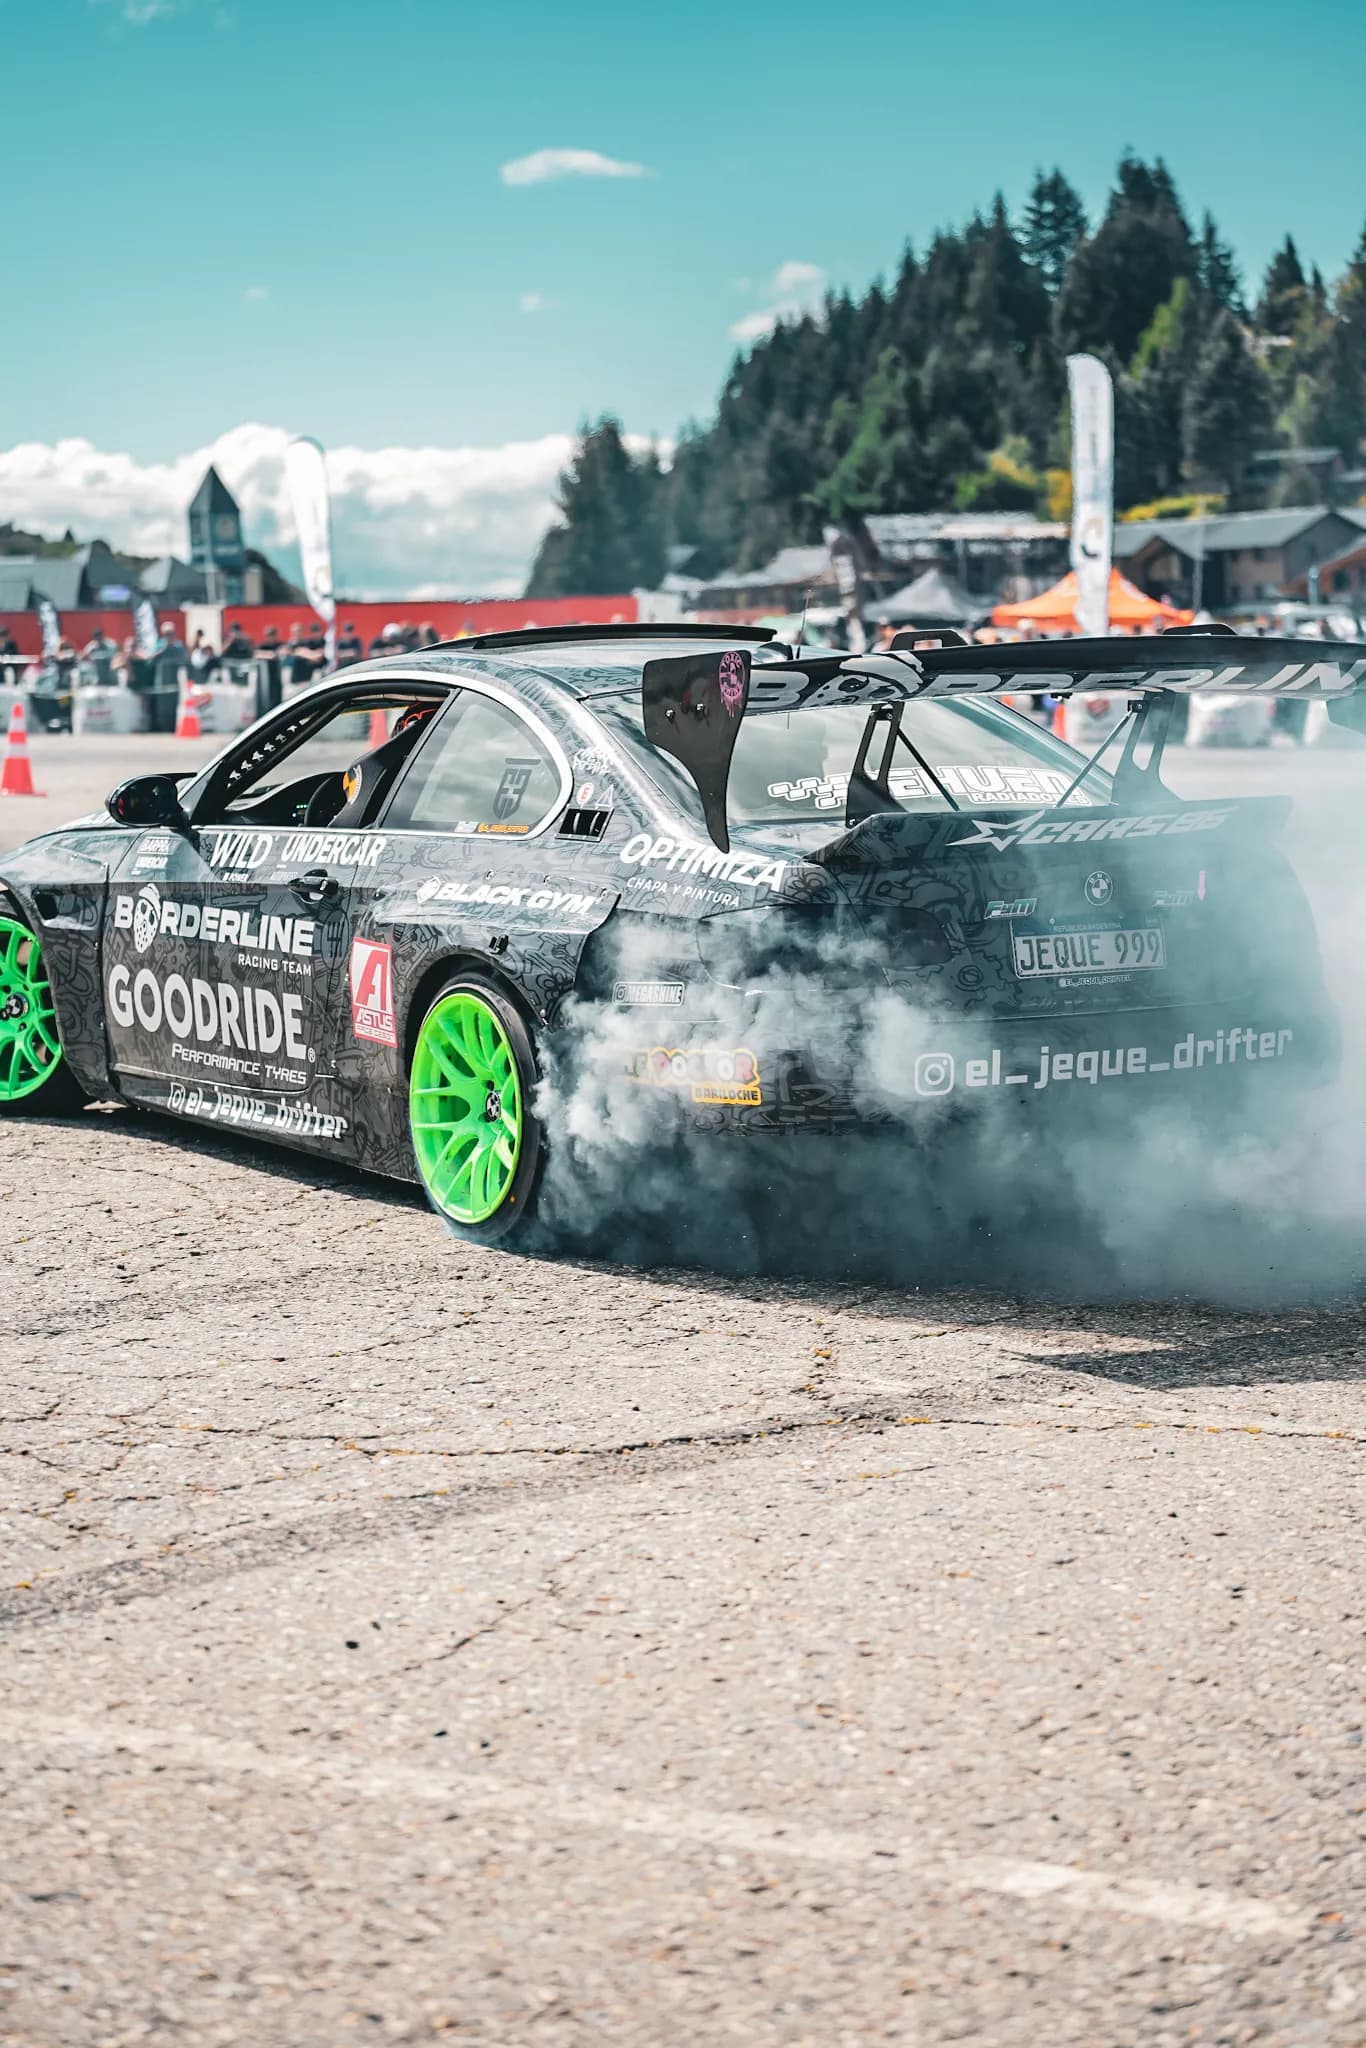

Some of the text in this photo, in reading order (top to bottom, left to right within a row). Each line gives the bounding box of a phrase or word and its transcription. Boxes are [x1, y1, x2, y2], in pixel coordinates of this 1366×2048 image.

[281, 834, 387, 867] UNDERCAR
[619, 833, 788, 892] OPTIMIZA
[434, 883, 597, 915] BLACK GYM
[626, 876, 740, 907] CHAPA Y PINTURA
[238, 953, 312, 977] RACING TEAM
[1020, 930, 1162, 971] JEQUE 999
[108, 964, 307, 1060] GOODRIDE
[356, 1007, 393, 1032] ASTUS
[171, 1043, 307, 1085] PERFORMANCE TYRES
[965, 1027, 1293, 1089] el_jeque_drifter
